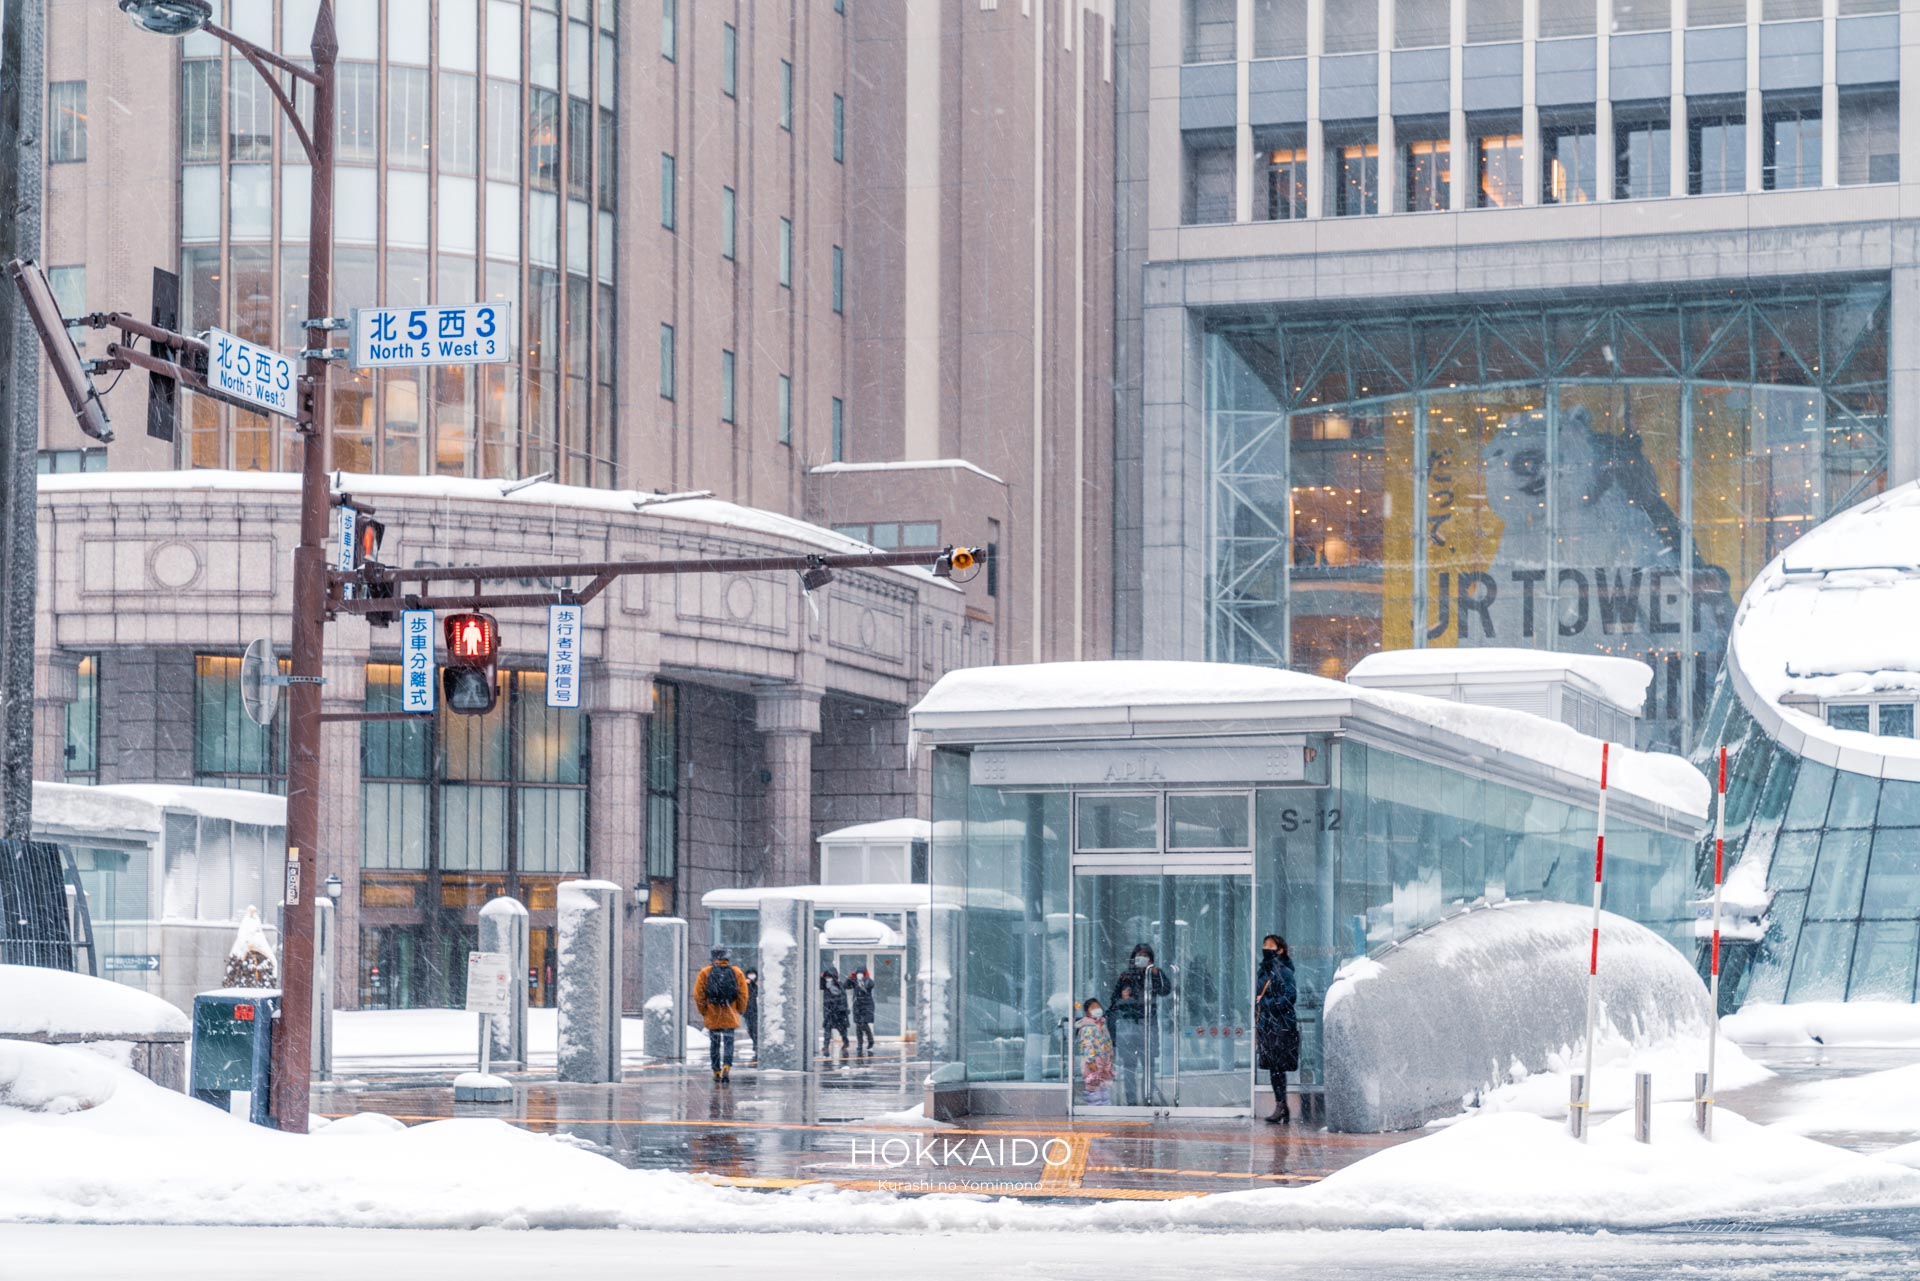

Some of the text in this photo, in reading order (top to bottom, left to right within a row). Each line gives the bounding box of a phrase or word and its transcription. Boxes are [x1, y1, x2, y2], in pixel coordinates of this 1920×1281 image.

[370, 339, 496, 360] North 5 West 3
[220, 370, 286, 408] North 5 West 3
[1410, 570, 1498, 640] JR
[410, 616, 428, 706] 歩車分離式
[555, 610, 575, 702] 歩行者支援信号
[1281, 808, 1342, 833] S-12
